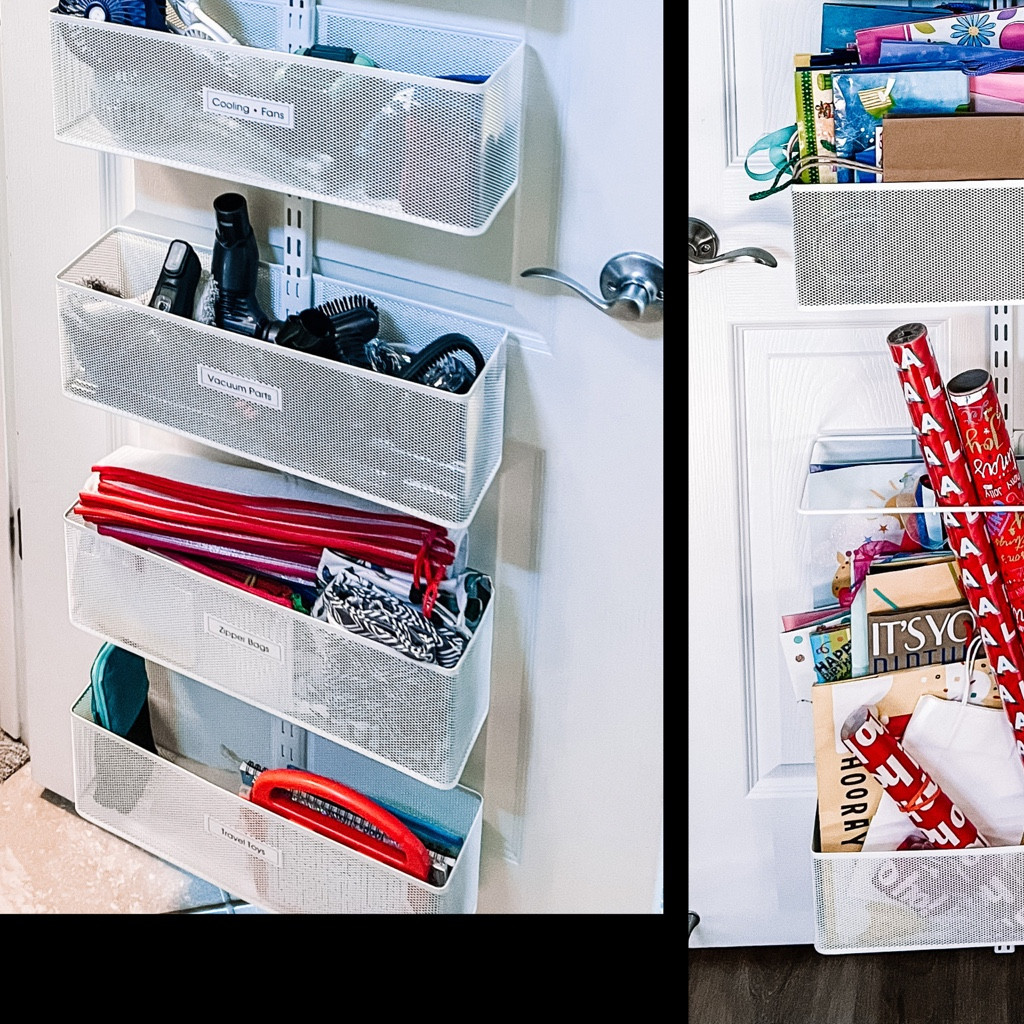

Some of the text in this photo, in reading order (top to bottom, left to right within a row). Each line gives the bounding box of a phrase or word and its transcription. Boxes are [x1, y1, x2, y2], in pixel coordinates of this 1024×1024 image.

[212, 97, 285, 120] Cooling Fans
[207, 374, 272, 401] Vacuum Parts
[219, 626, 270, 653] Zipper Bags
[815, 640, 851, 673] HAPP
[840, 755, 870, 845] HOORAY
[221, 828, 266, 856] Travel Toys
